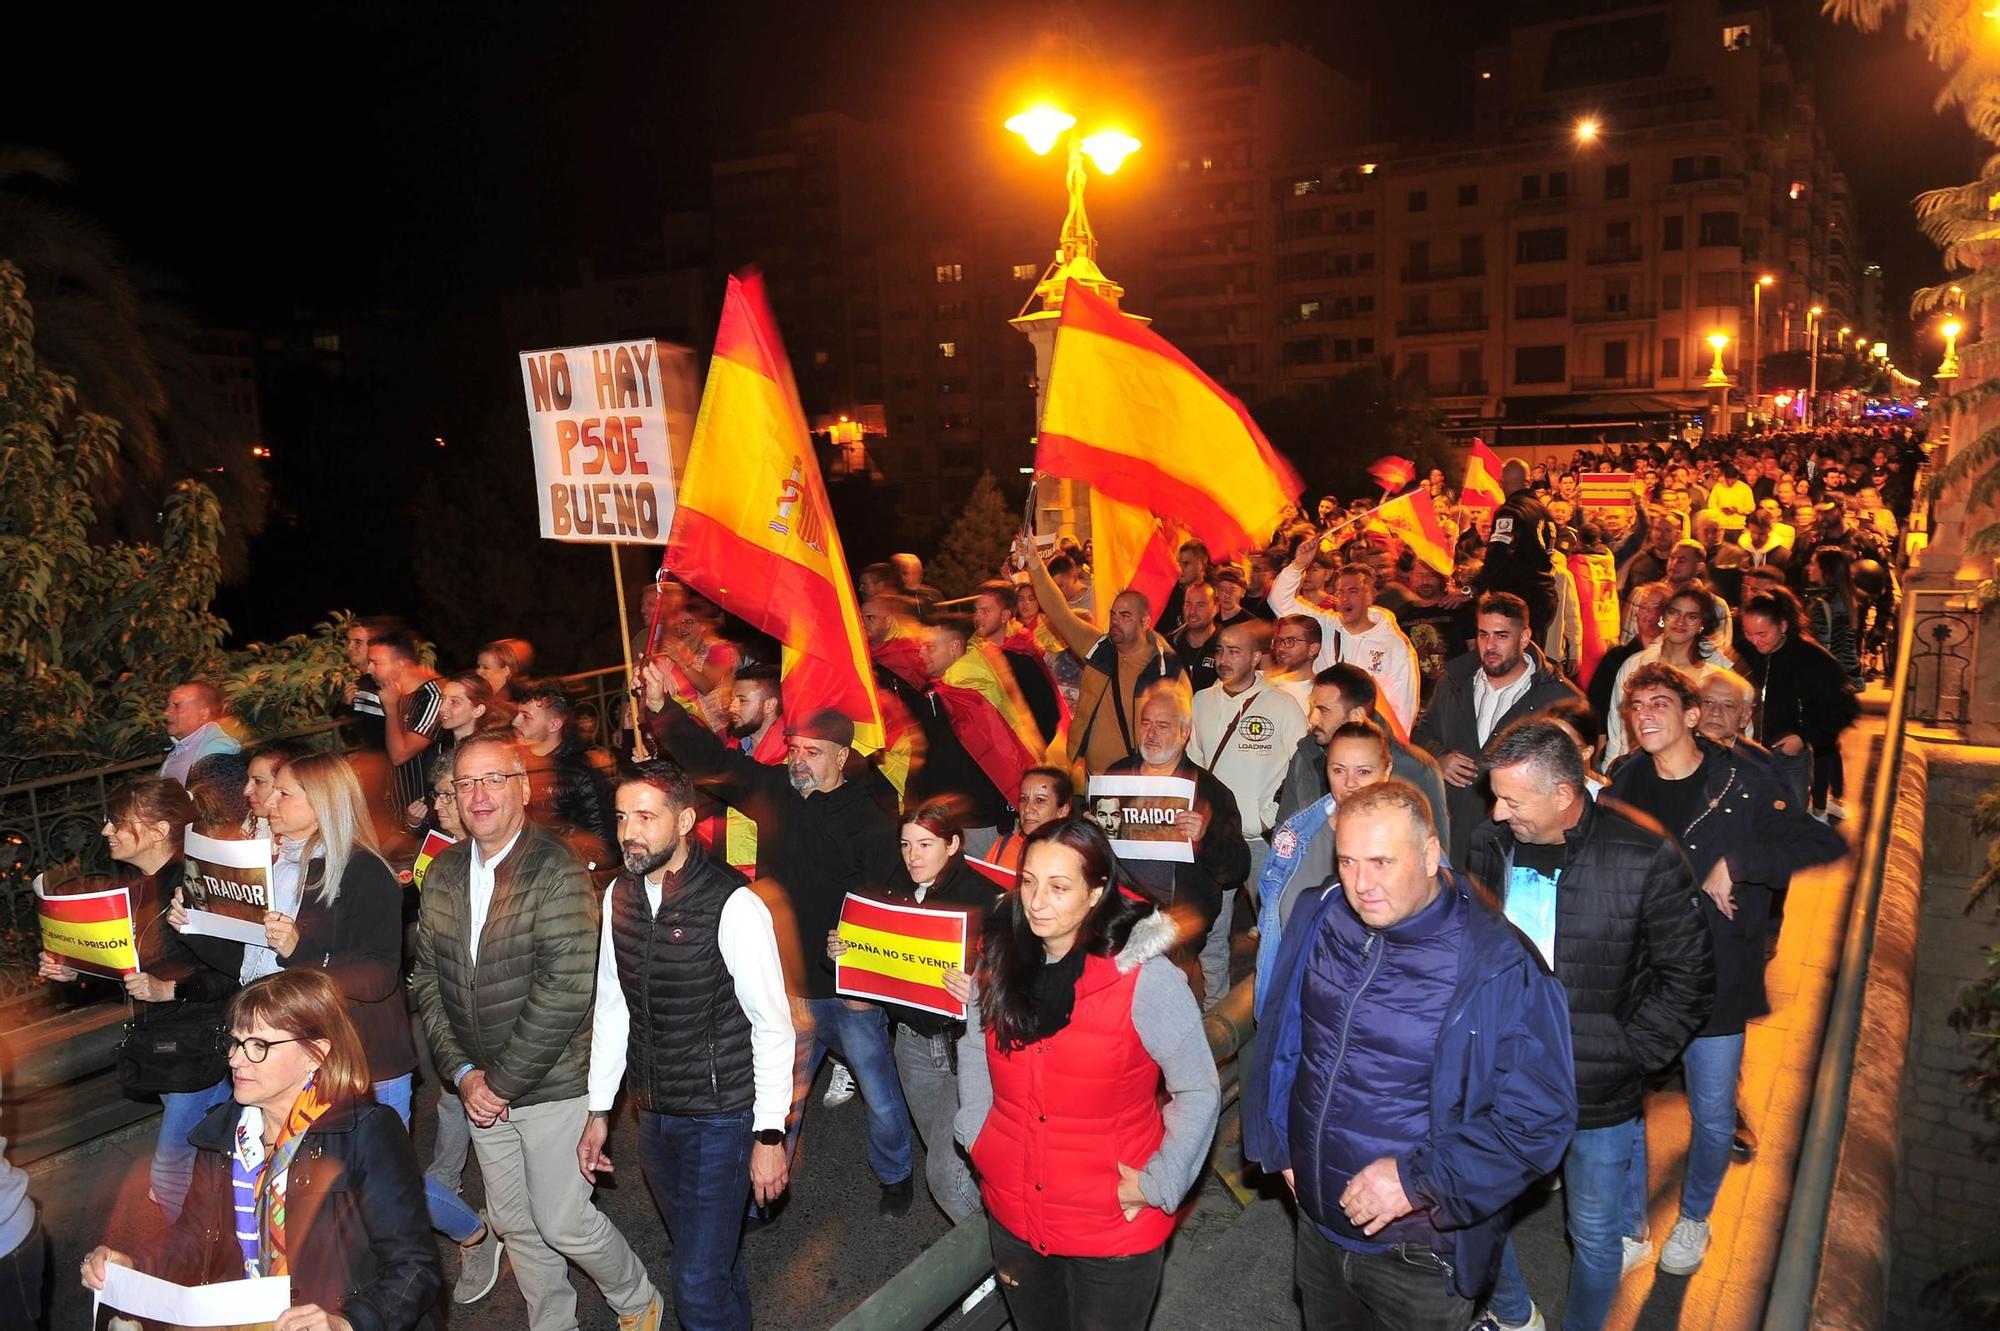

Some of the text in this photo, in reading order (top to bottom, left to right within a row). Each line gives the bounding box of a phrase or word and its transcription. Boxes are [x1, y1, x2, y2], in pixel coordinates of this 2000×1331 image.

[528, 344, 653, 412] NO HAY
[556, 416, 649, 475] PSOE
[550, 482, 659, 539] BUENO
[1122, 808, 1185, 825] TRAIDO
[203, 875, 265, 906] TRAIDOR
[84, 937, 128, 949] PRISIÓN
[882, 949, 899, 959] NO
[902, 953, 915, 963] SE
